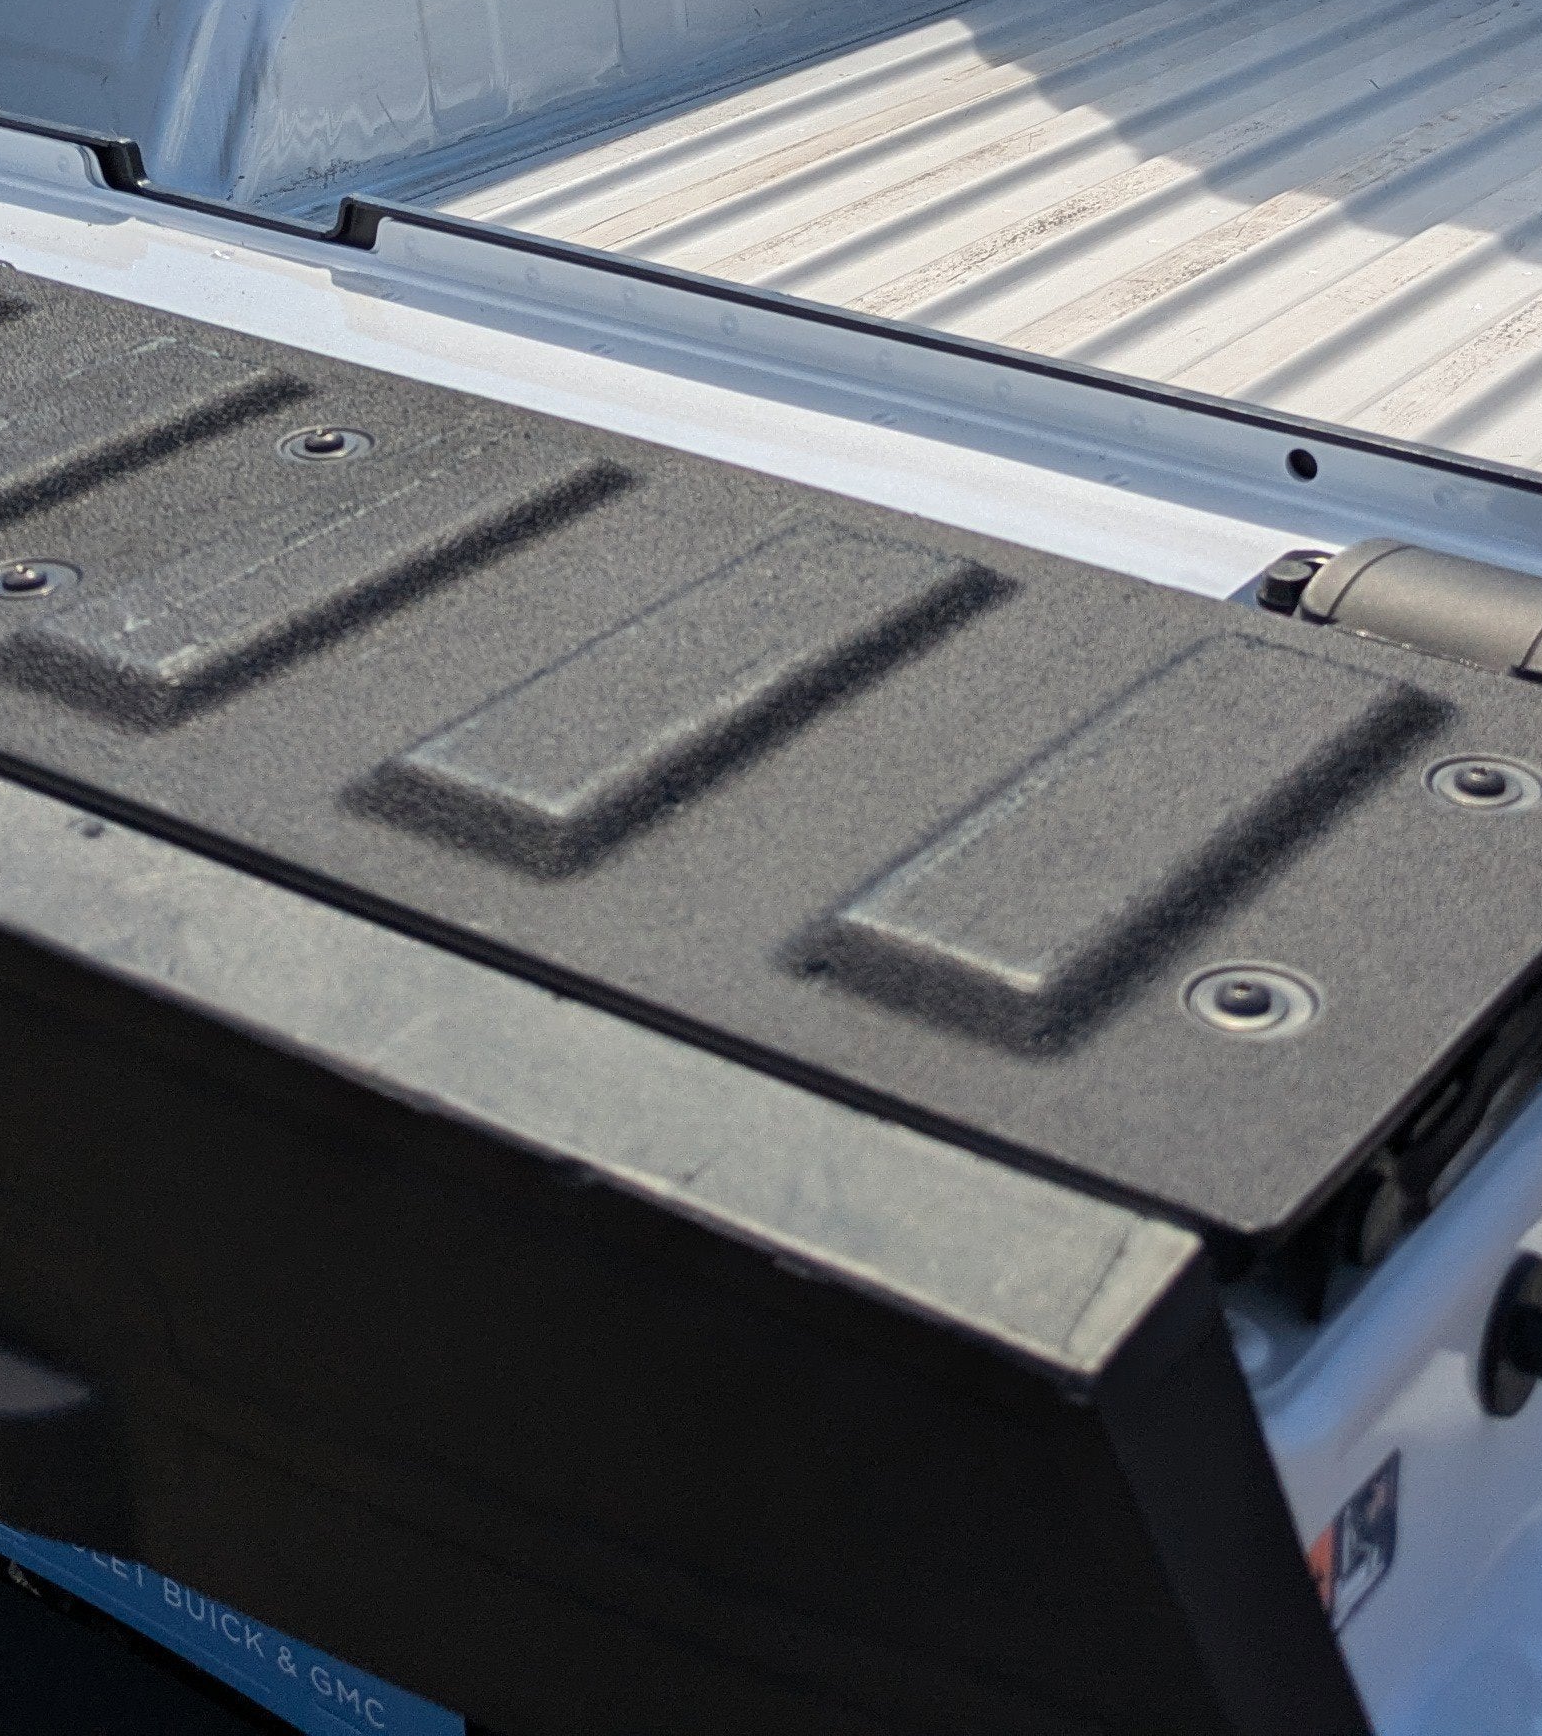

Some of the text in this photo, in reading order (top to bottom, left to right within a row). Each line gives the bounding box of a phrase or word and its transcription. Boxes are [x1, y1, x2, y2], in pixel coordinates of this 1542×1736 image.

[72, 1544, 385, 1729] LET BUICK & GMC
